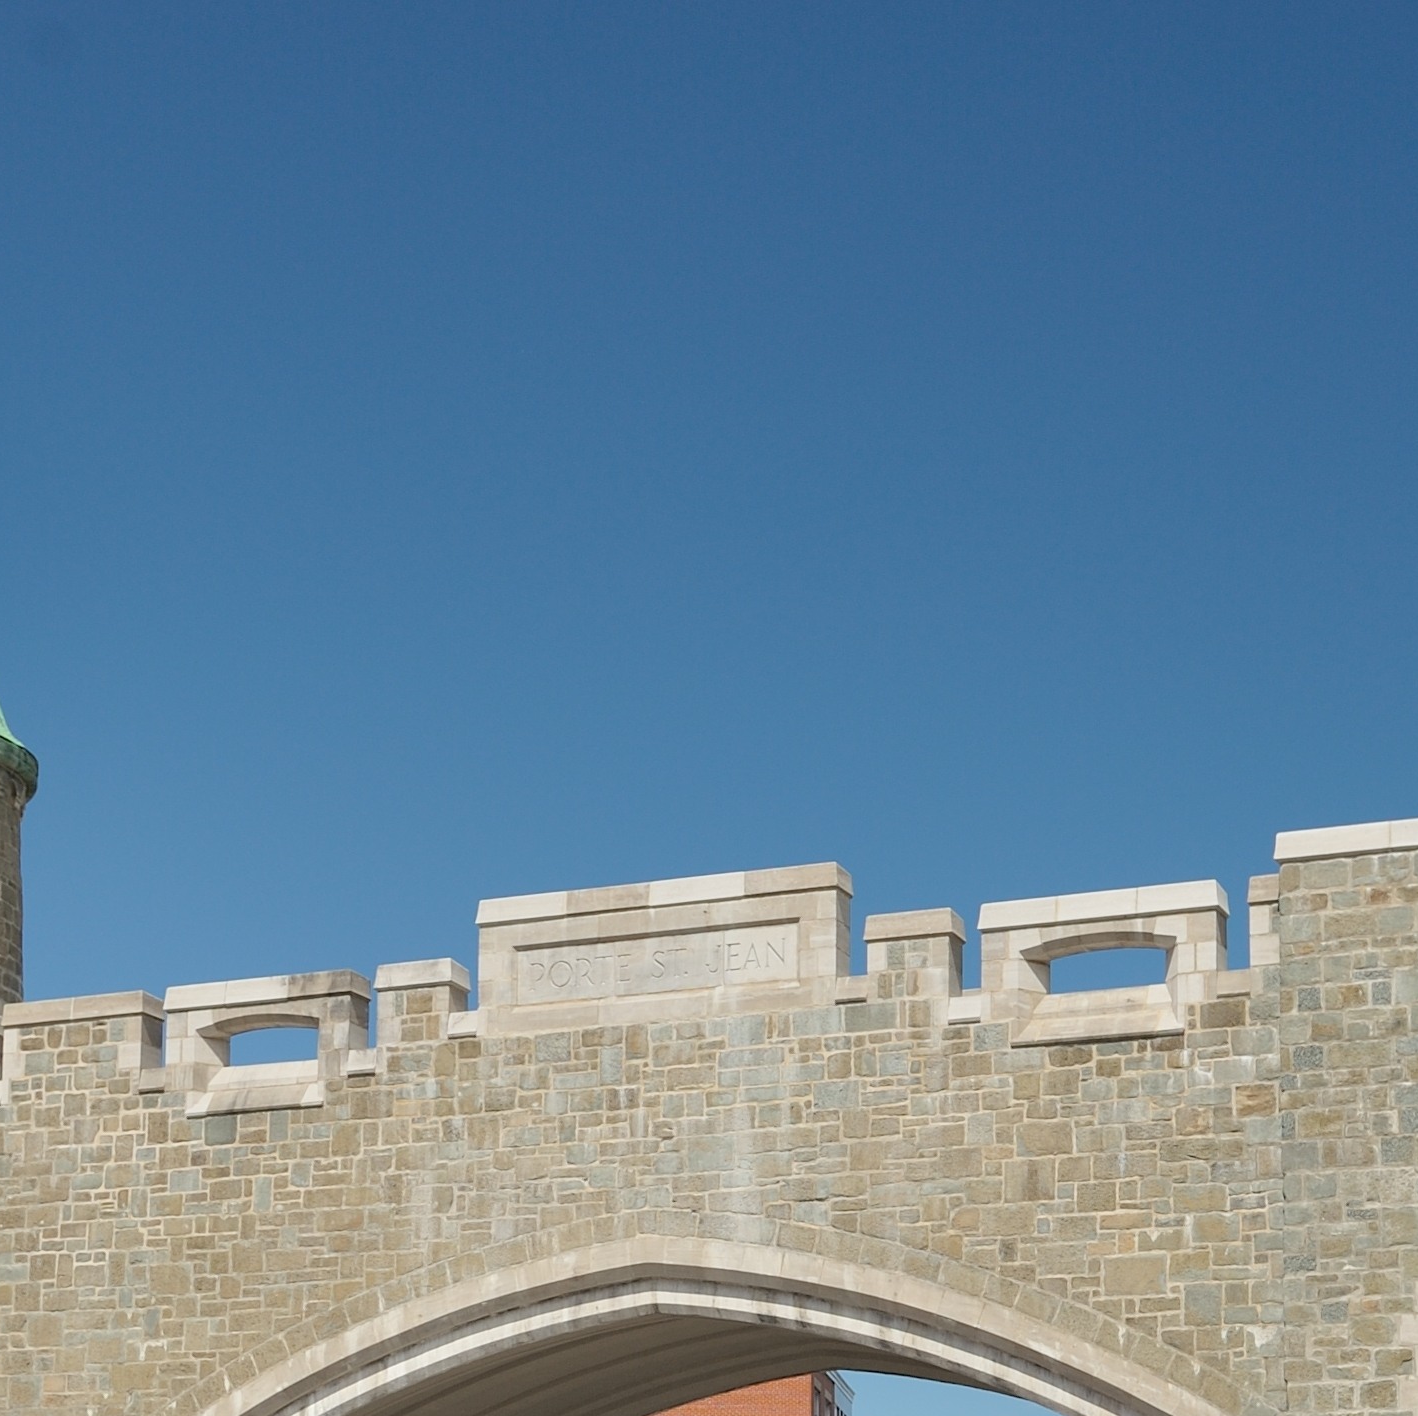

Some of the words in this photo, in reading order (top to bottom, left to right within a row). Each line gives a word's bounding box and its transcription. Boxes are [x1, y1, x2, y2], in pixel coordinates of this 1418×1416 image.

[530, 953, 632, 992] PORTE
[650, 946, 688, 980] ST.
[704, 937, 787, 973] JEAN
